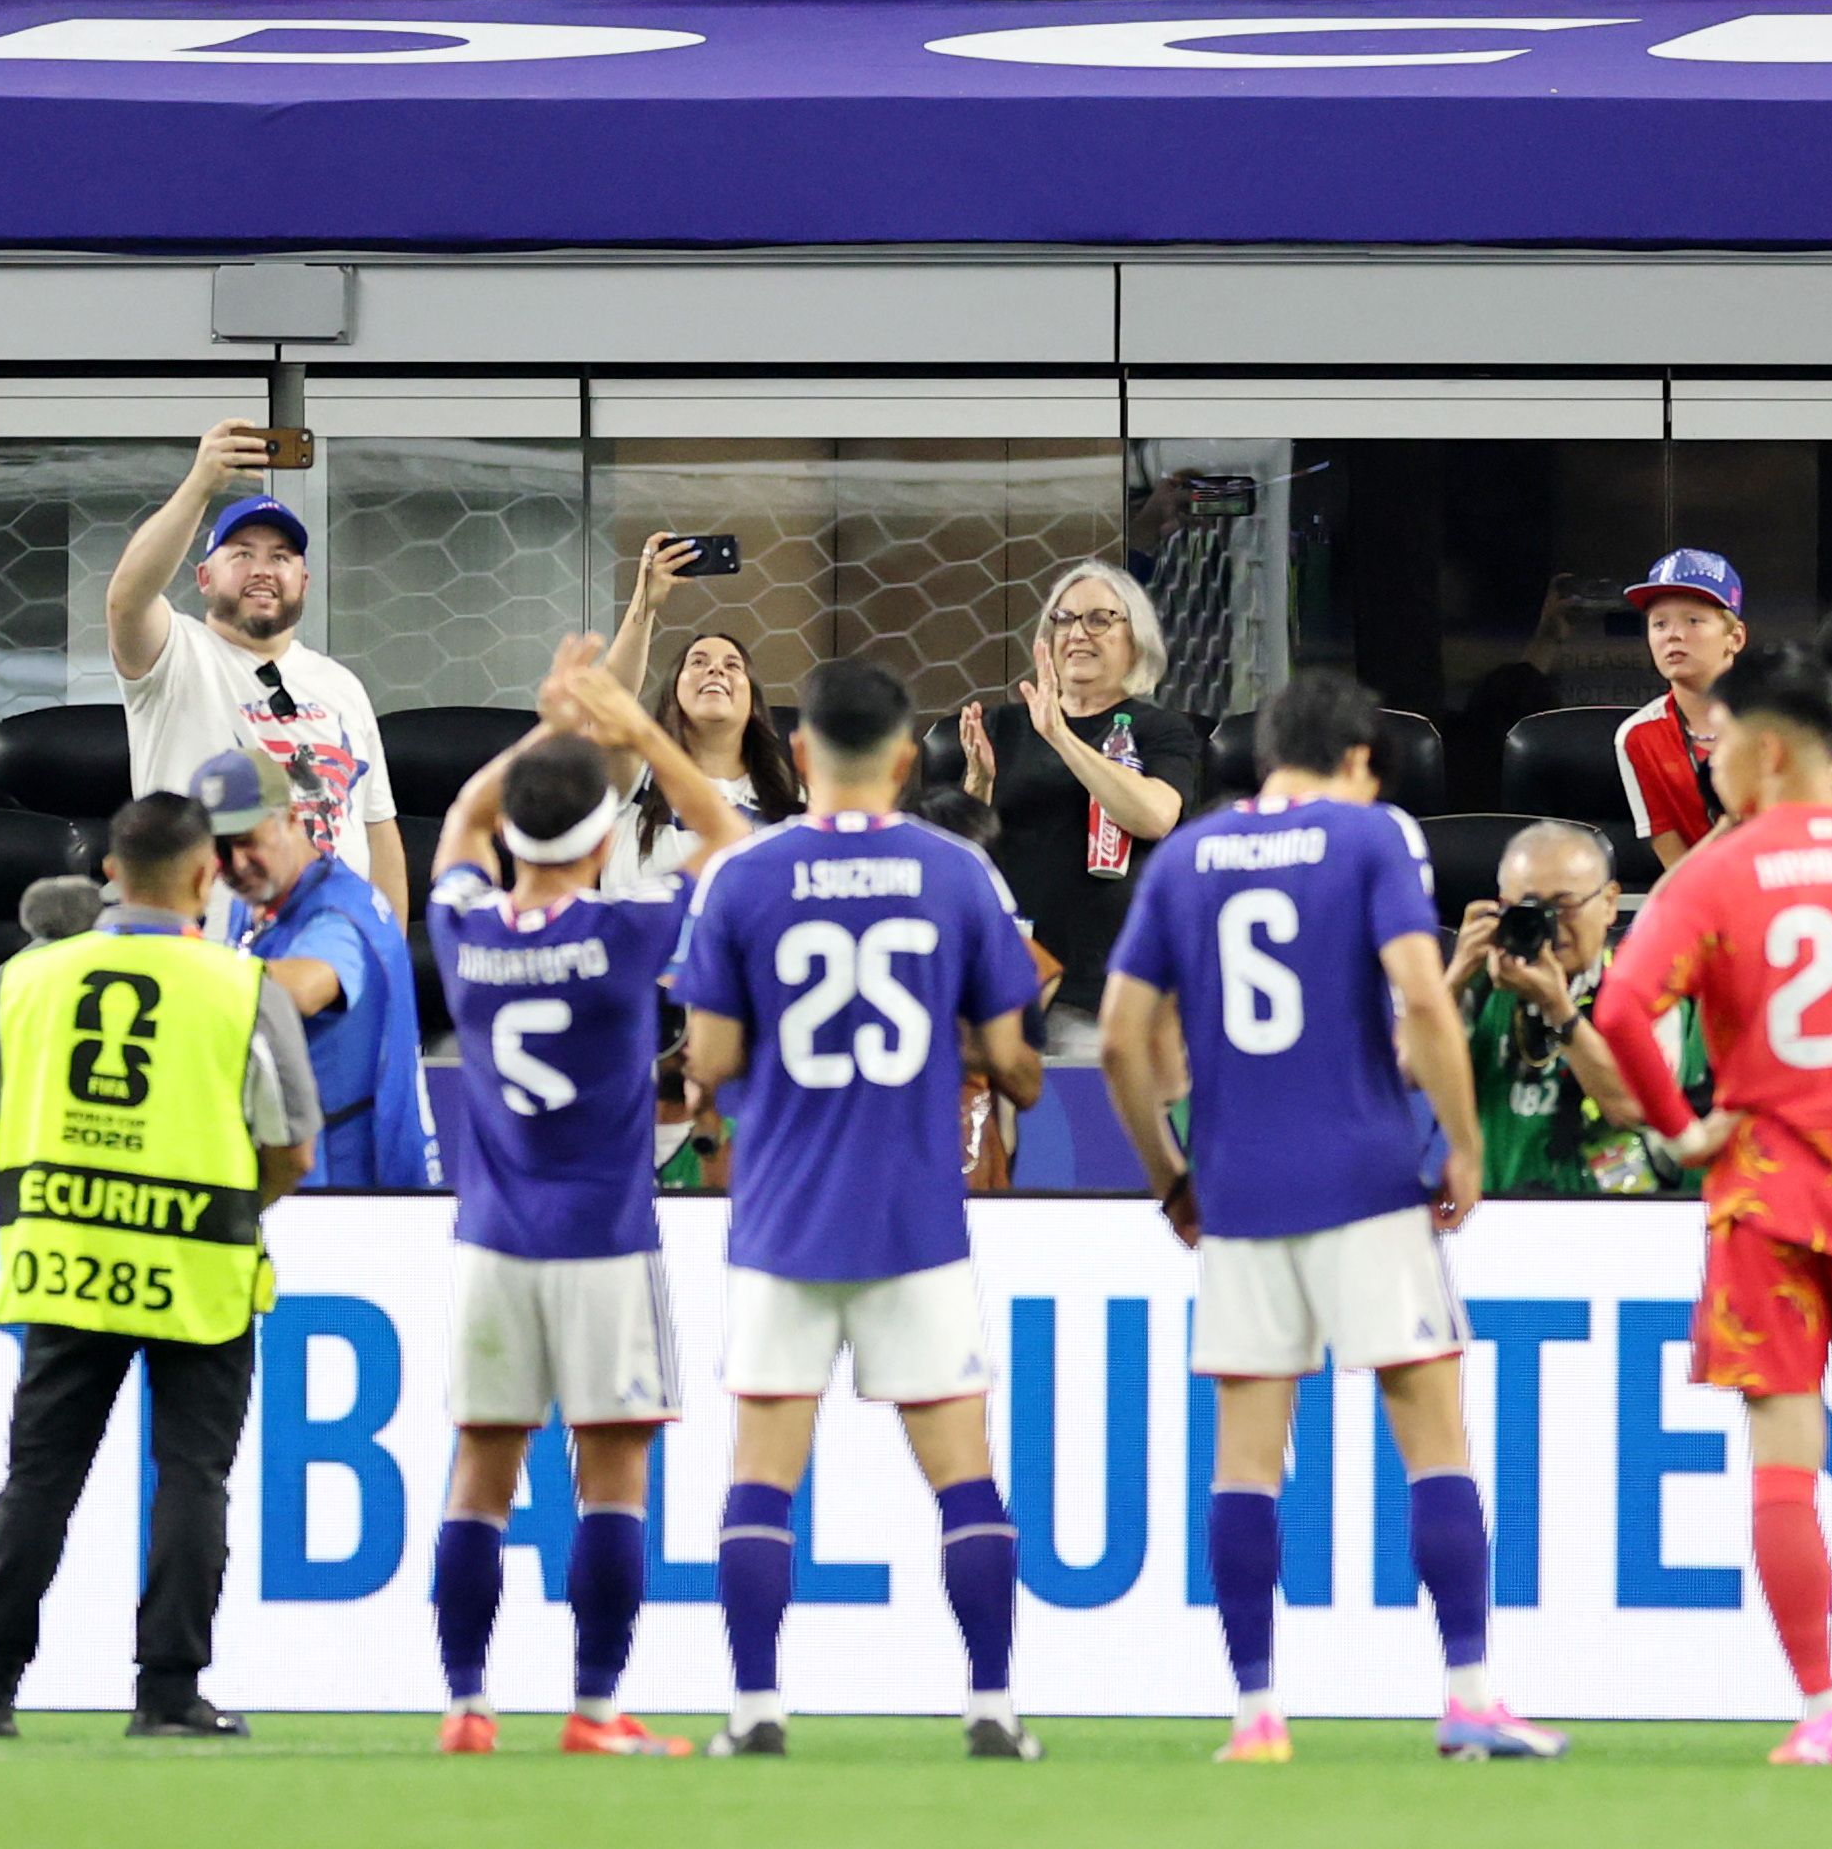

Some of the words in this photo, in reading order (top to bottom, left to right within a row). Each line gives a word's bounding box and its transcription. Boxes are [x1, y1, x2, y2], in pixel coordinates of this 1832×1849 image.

[1195, 828, 1327, 874] MACHINO
[791, 857, 923, 902] J.SUZUKI
[1216, 886, 1304, 1057] 6
[775, 917, 940, 1089] 25
[490, 997, 578, 1117] 5
[86, 1076, 130, 1100] FIFA
[60, 1126, 144, 1153] 2026
[63, 1111, 114, 1127] WORLD
[116, 1111, 145, 1127] CUP
[13, 1247, 173, 1312] 03285
